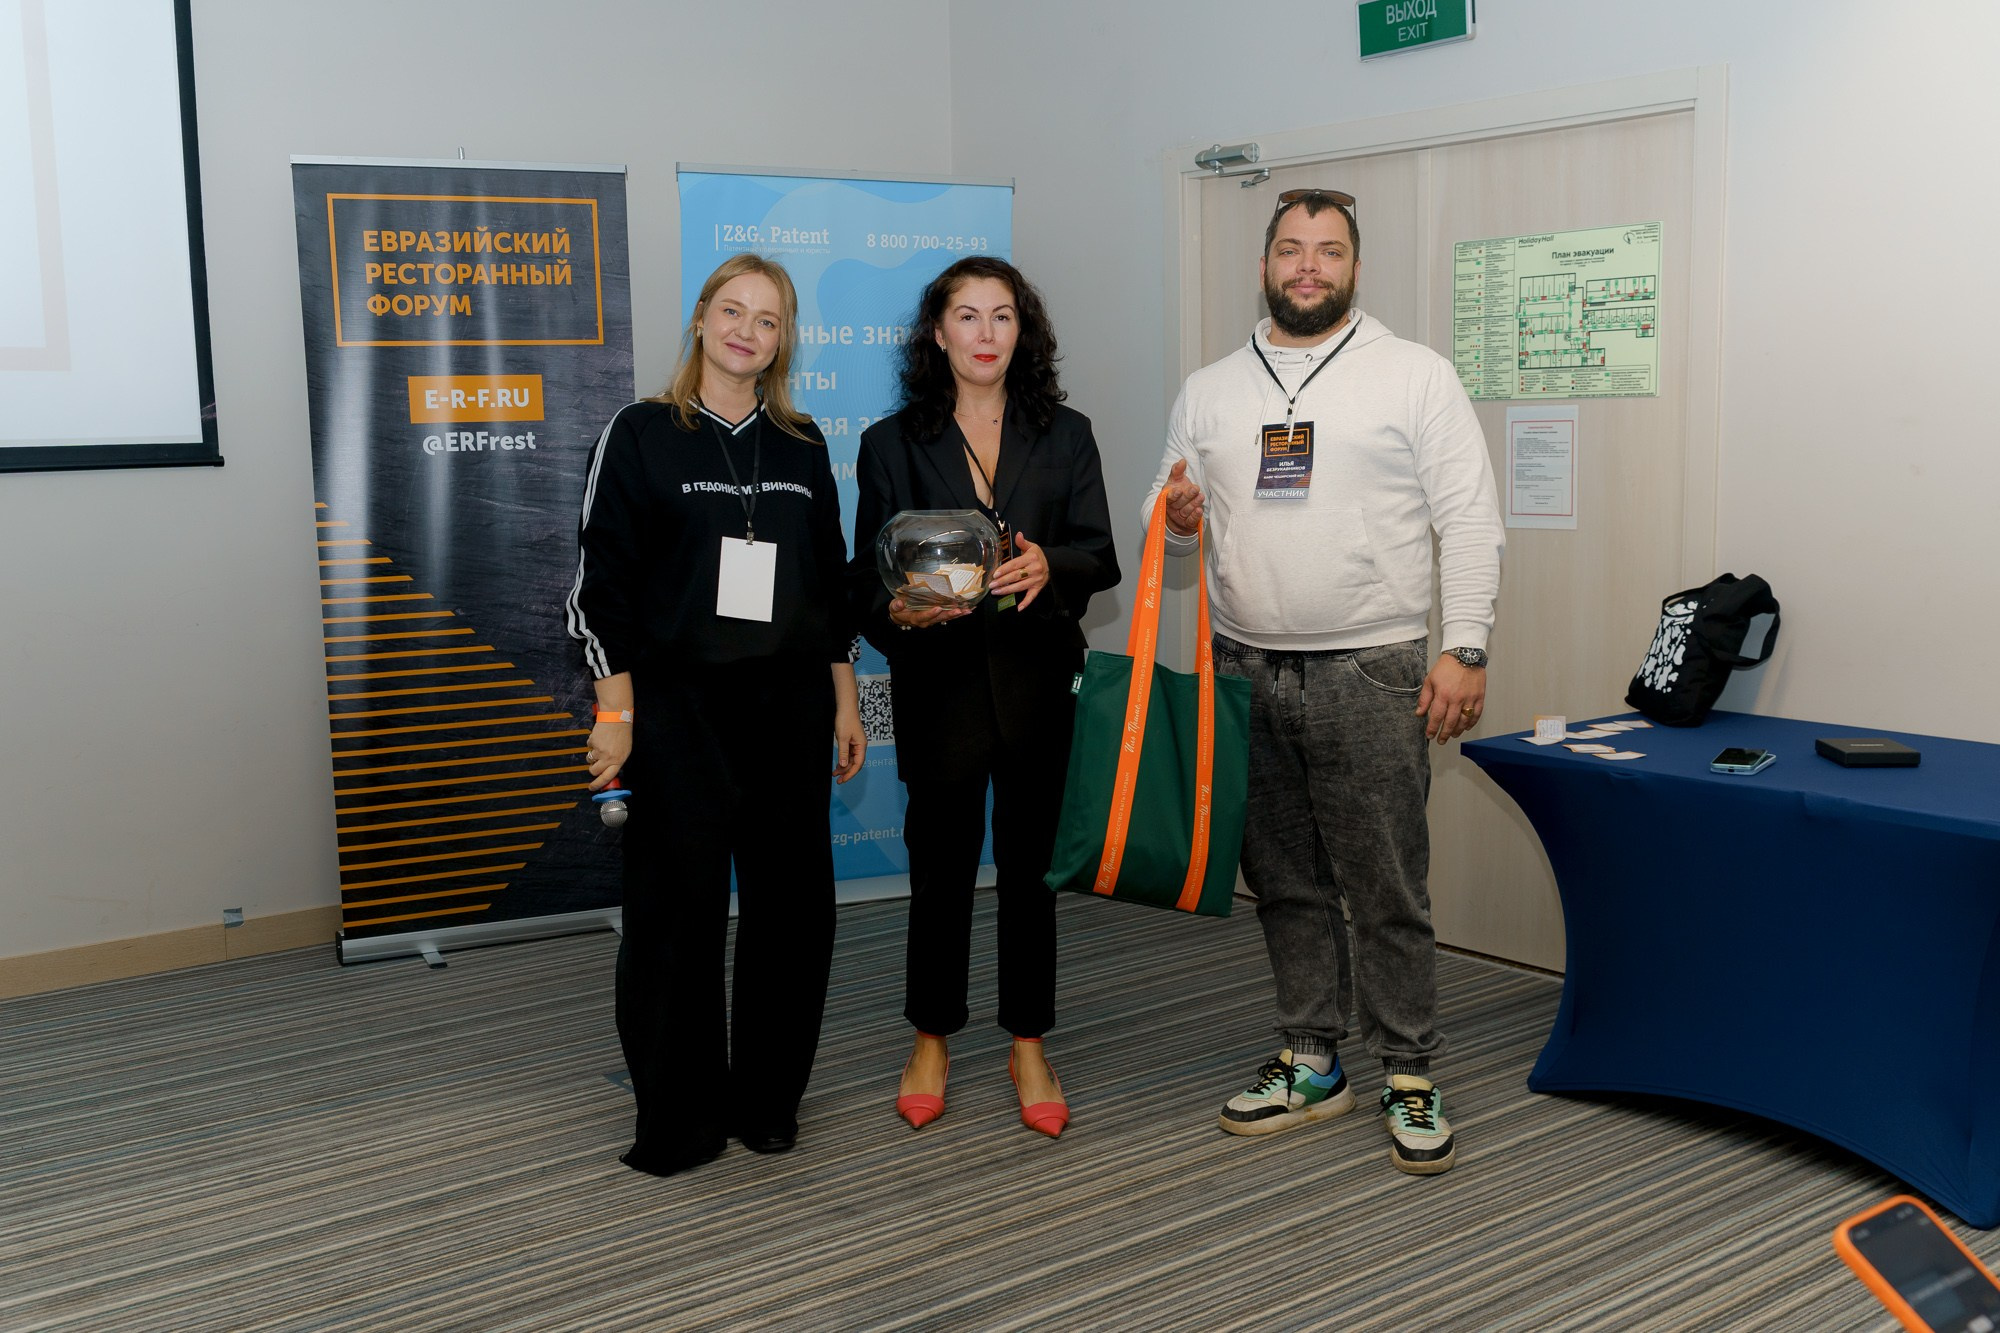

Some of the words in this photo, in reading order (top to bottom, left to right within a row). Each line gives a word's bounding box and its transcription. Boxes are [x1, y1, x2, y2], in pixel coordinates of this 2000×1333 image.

[1386, 0, 1437, 24] ВЫХОД
[1398, 22, 1428, 41] EXIT
[362, 226, 571, 254] ЕВРАЗИЙСКИЙ
[723, 224, 765, 243] Z&G.
[770, 226, 830, 245] Patent
[866, 233, 876, 248] 8
[880, 234, 908, 249] 800
[912, 235, 988, 251] 700-25-93
[1551, 251, 1571, 259] План
[1572, 247, 1615, 257] эвакуации
[365, 259, 572, 285] РЕСТОРАННЫЙ
[366, 294, 472, 317] ФОРУМ
[800, 325, 853, 345] ные
[425, 388, 530, 409] E-R-F.RU
[422, 431, 536, 455] @ERFrest
[682, 483, 691, 494] В
[1257, 490, 1305, 498] УЧАСТНИК
